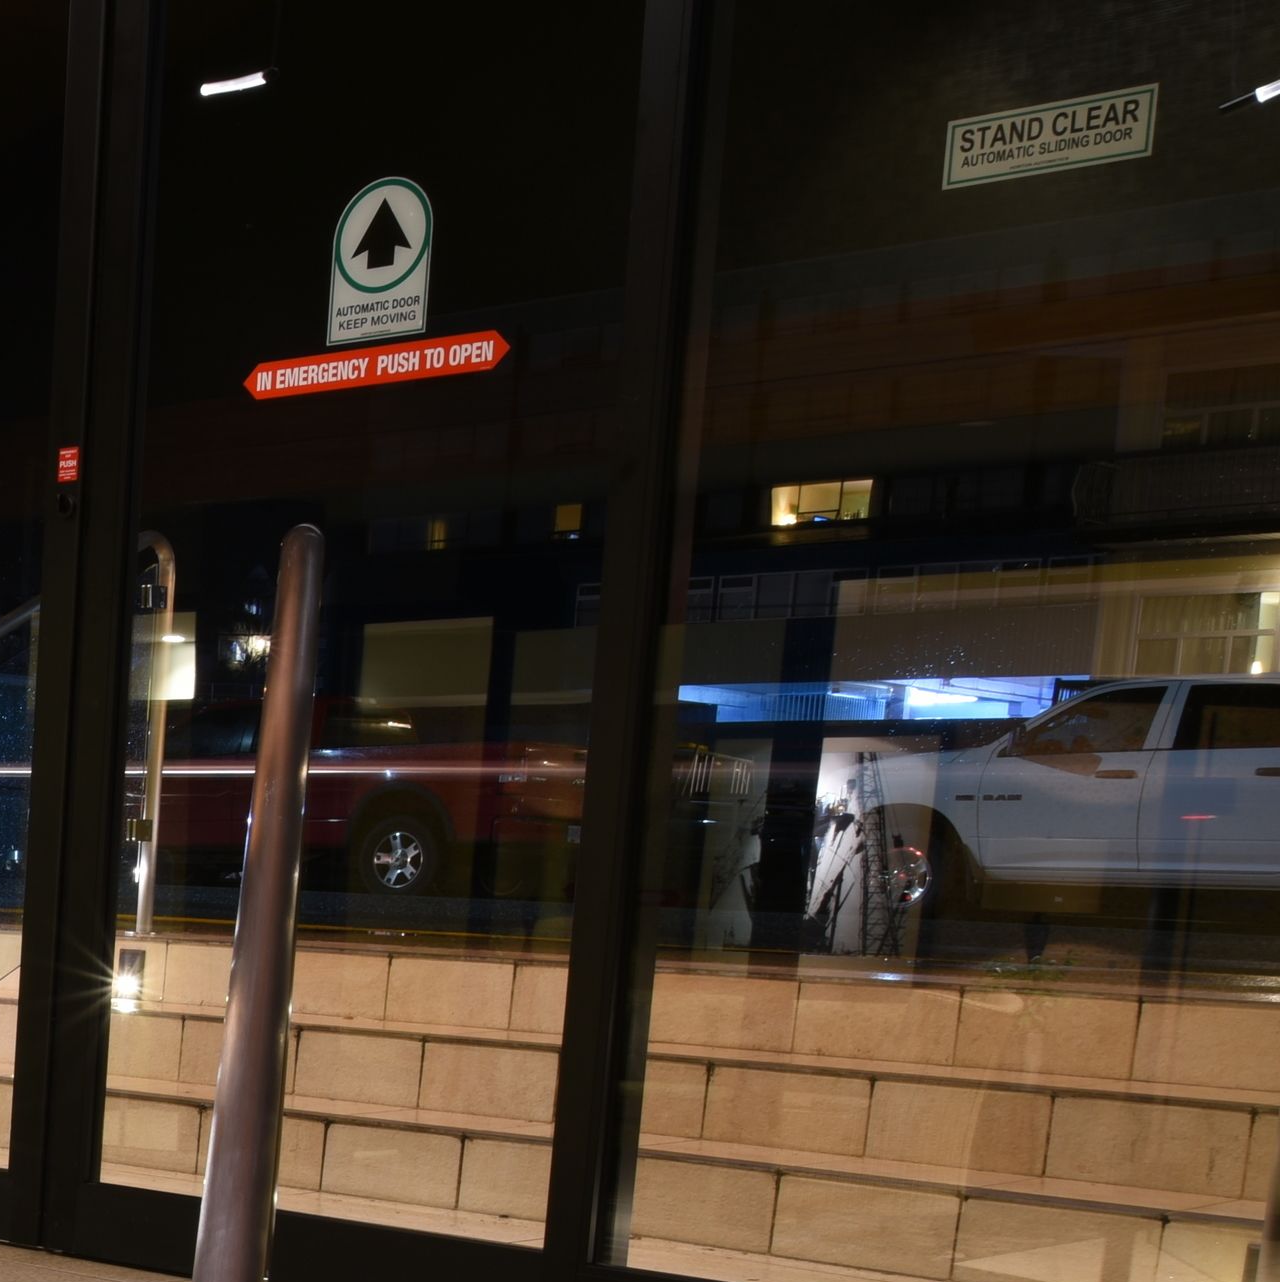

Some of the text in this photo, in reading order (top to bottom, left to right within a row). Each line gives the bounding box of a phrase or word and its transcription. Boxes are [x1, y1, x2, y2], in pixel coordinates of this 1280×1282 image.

[959, 99, 1140, 152] STAND CLEAR
[961, 144, 1035, 168] AUTOMATIC
[1039, 135, 1090, 155] SLIDING
[1093, 127, 1133, 146] DOOR
[336, 295, 420, 318] AUTOMATIC DOOR
[338, 310, 417, 331] KEEP MOVING
[256, 340, 495, 392] IN EMERGENCY PUSH TO OPEN
[59, 460, 77, 468] PUSH
